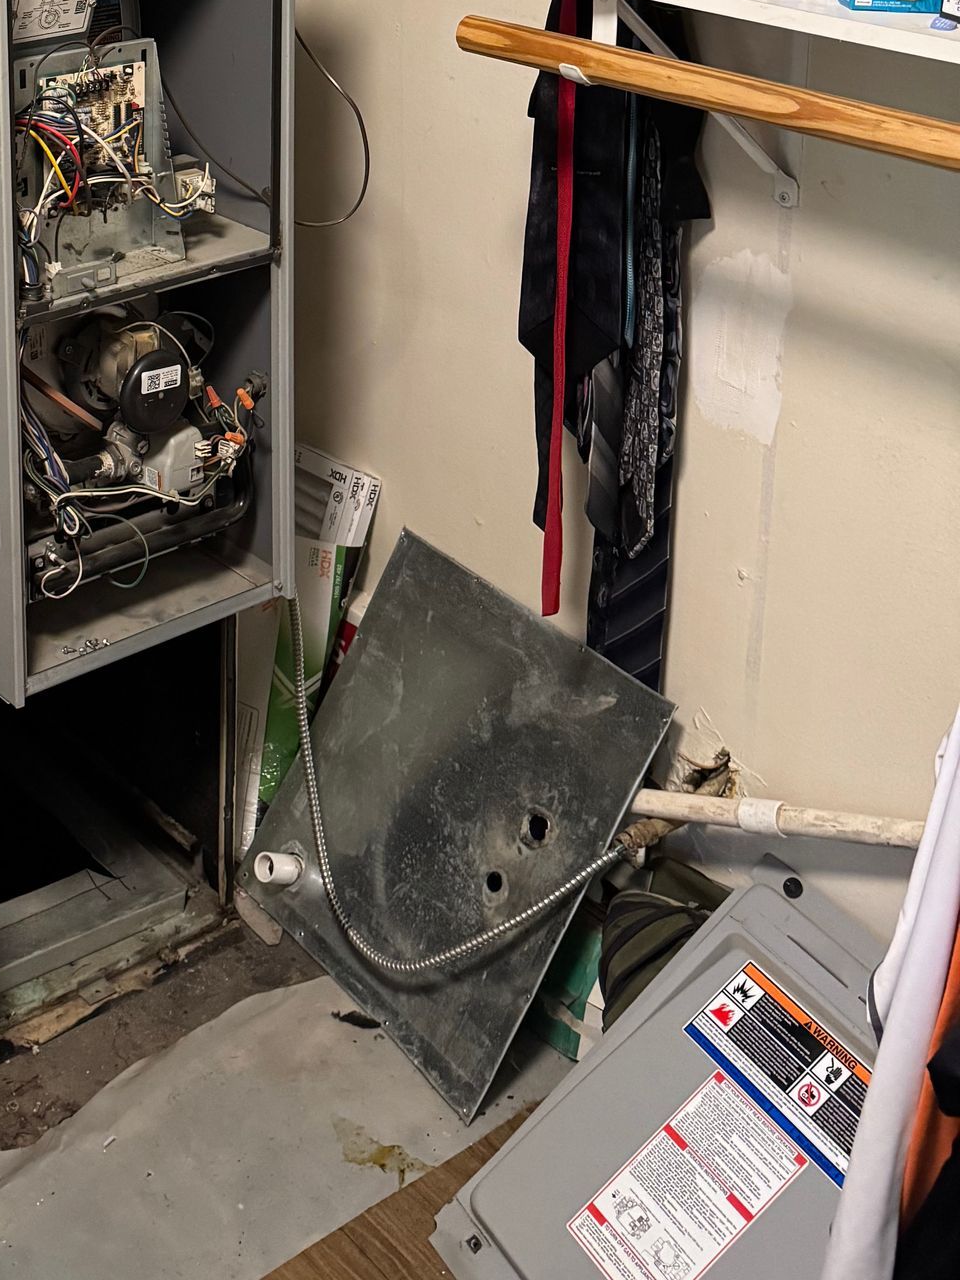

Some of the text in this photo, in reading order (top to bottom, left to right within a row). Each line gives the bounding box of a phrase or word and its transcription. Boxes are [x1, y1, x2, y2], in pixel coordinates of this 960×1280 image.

[329, 468, 347, 484] HDX
[350, 477, 361, 500] HDX
[367, 485, 378, 507] HDX
[320, 550, 332, 578] HDX
[813, 1027, 858, 1070] WARNING
[731, 1089, 796, 1156] YOUR SAFETY READ BEFORE OPERATING
[686, 1149, 728, 1196] OPERATING INSTRUCTIONS
[609, 1230, 618, 1240] TURN
